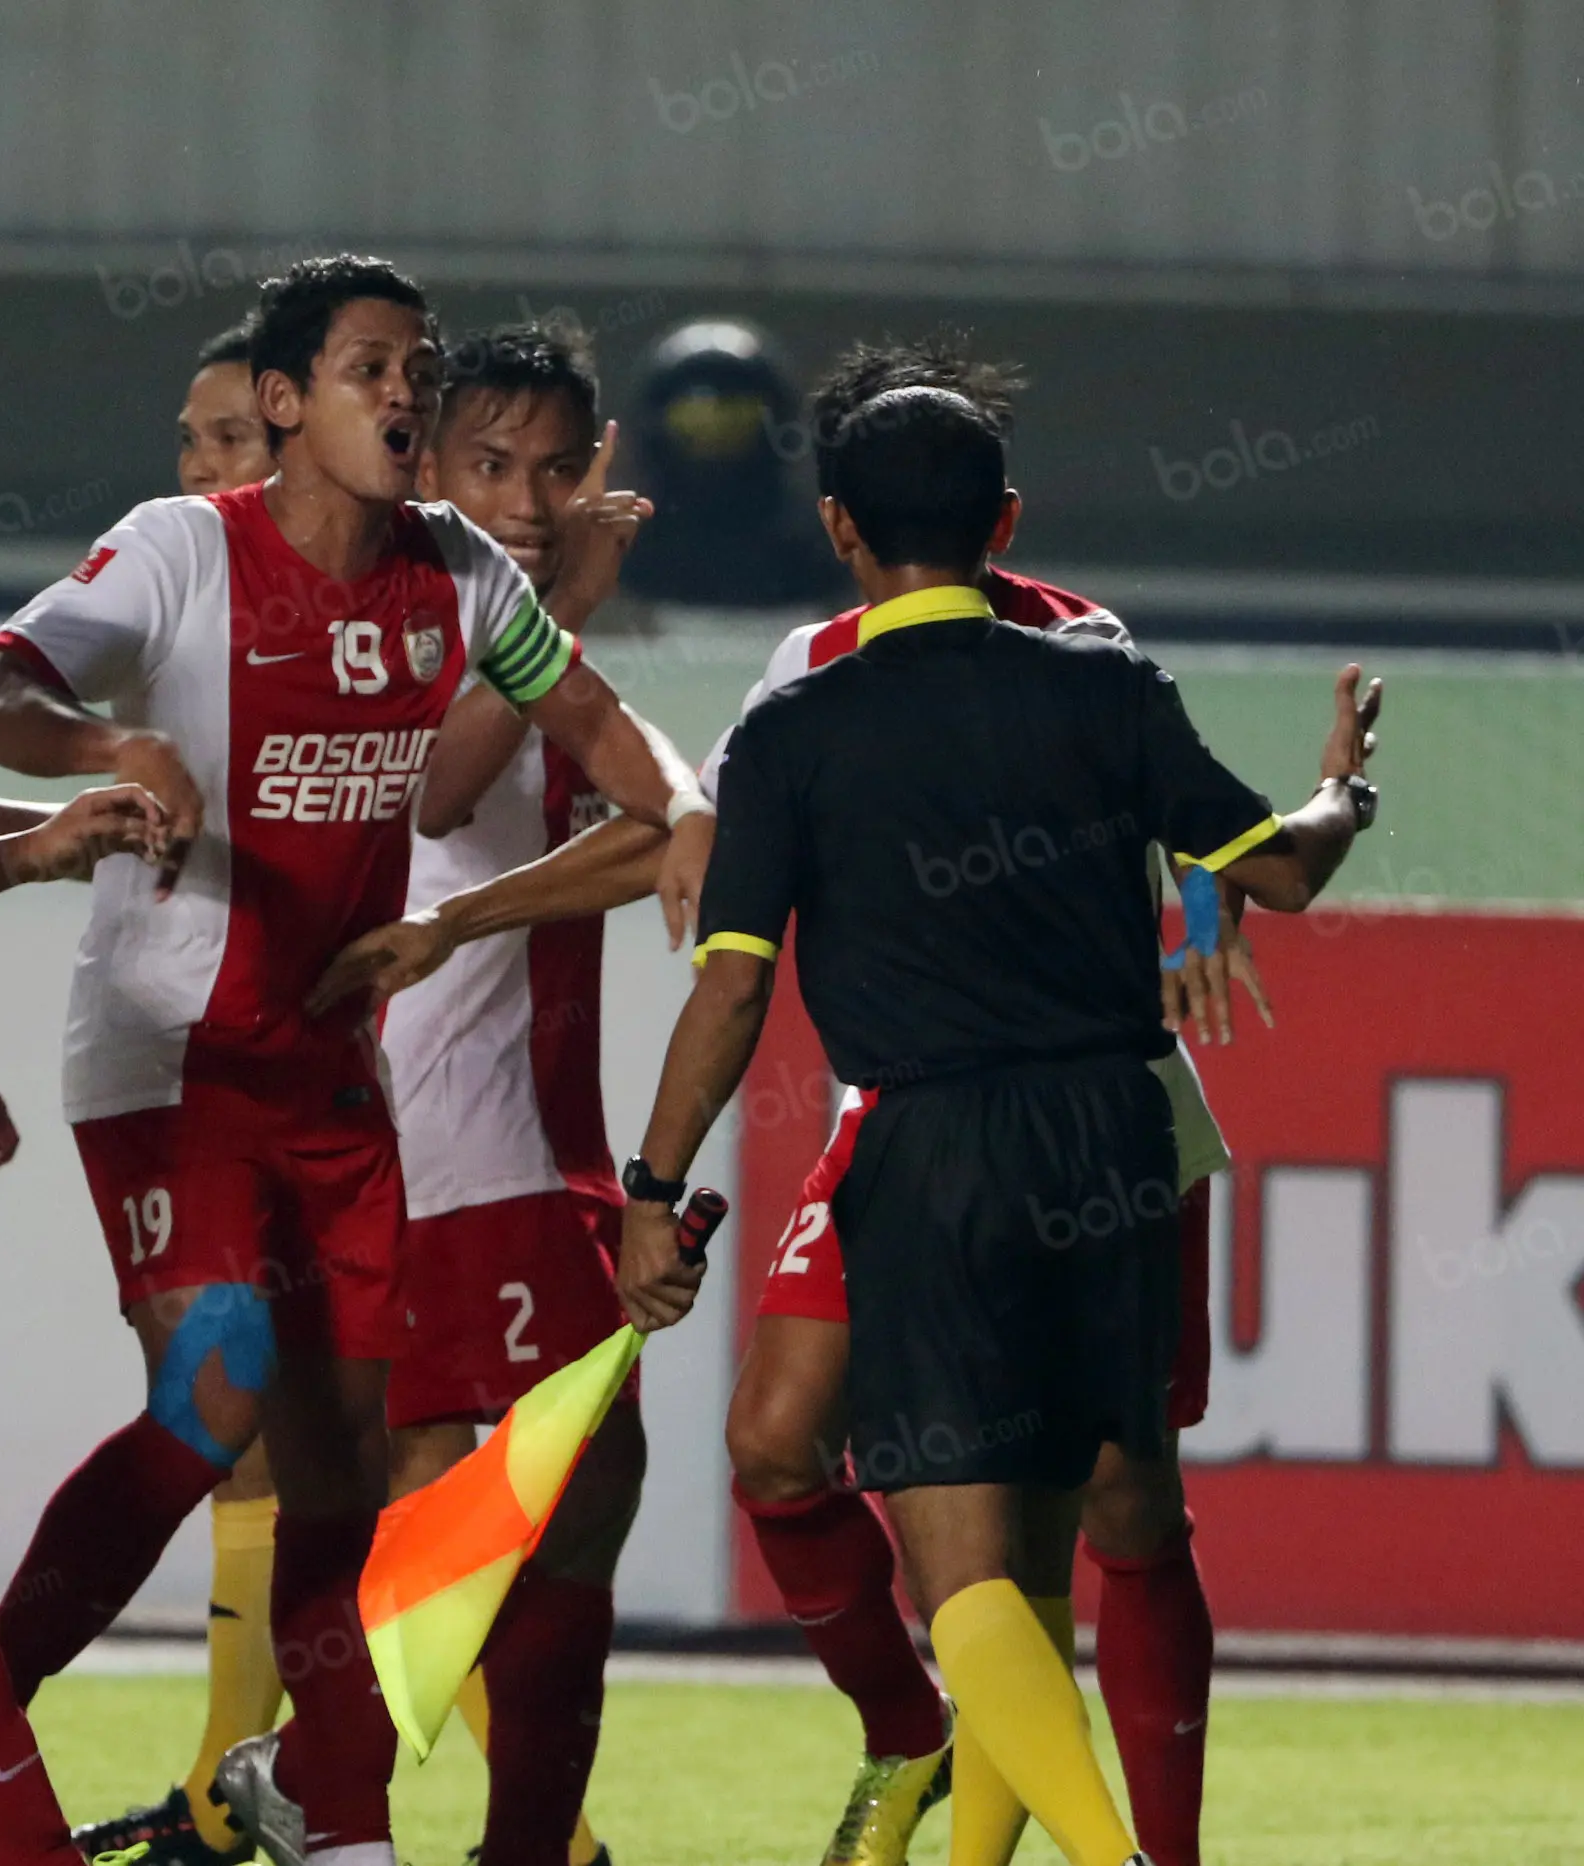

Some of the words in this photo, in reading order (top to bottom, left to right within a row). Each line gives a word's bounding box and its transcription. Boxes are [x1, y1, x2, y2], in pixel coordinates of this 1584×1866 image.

[327, 619, 389, 695] 19
[122, 1187, 174, 1267] 19
[497, 1281, 541, 1363] 2
